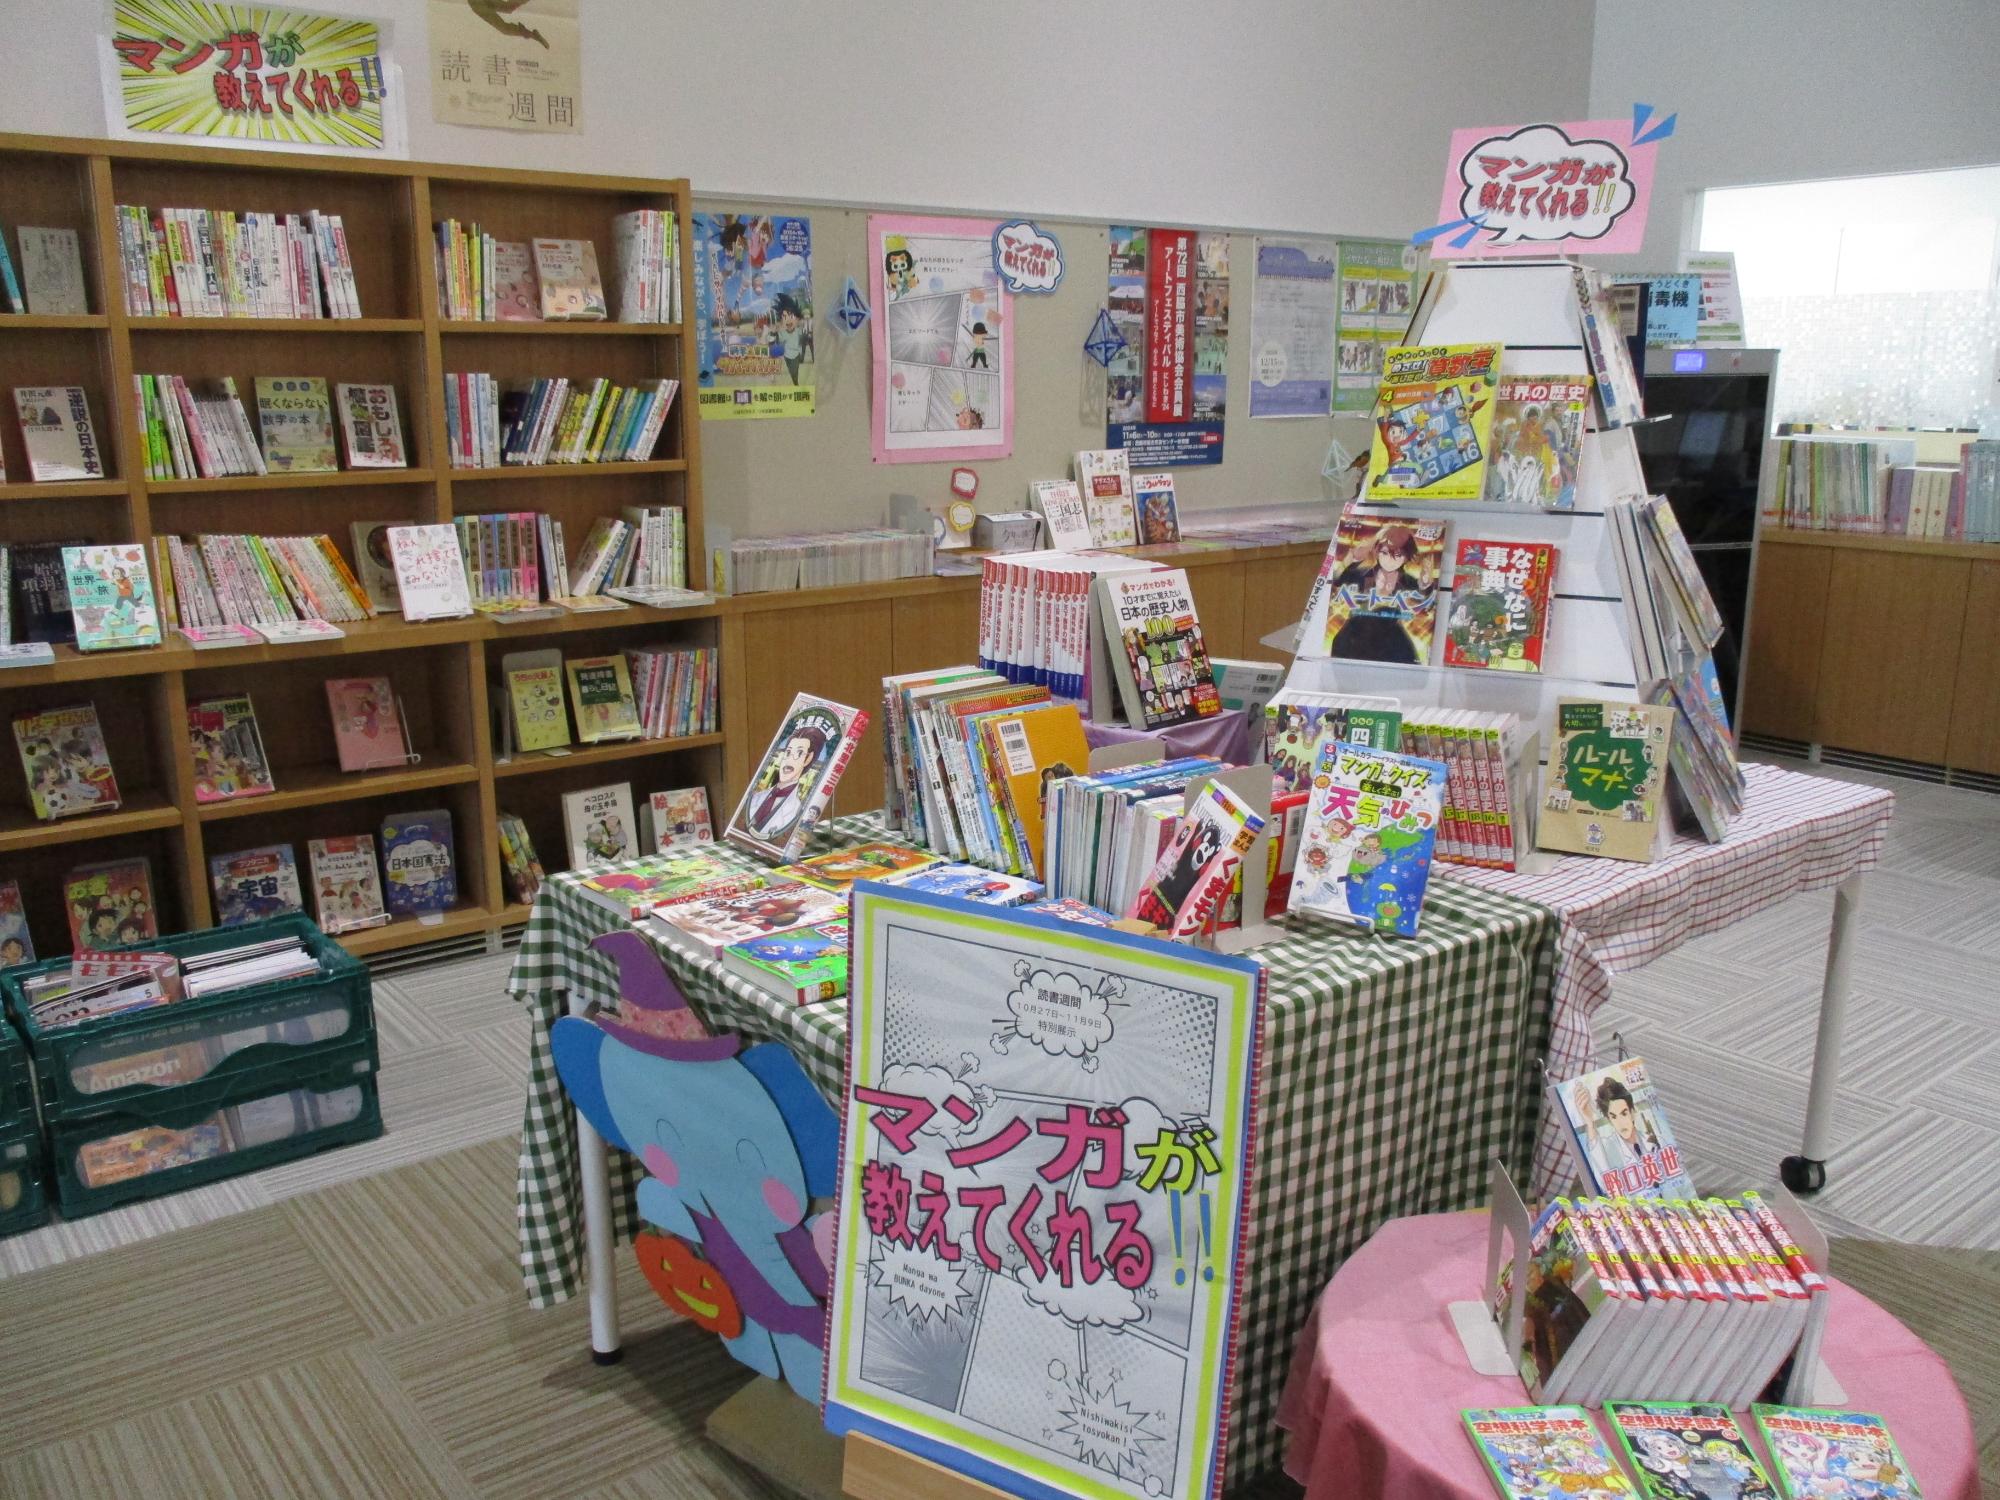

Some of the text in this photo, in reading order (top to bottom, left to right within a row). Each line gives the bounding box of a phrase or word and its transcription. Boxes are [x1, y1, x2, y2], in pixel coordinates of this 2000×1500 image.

[112, 30, 305, 74] マンガが
[440, 50, 511, 86] 読書
[508, 92, 574, 127] 週間
[1476, 155, 1617, 187] マンガが
[1176, 236, 1188, 278] 第72回
[1162, 247, 1174, 368] アートフェスティバル
[1648, 290, 1690, 309] 毒機
[258, 396, 328, 410] 眠くならない
[1381, 391, 1394, 402] 4
[1500, 384, 1586, 402] 世界の歴史
[261, 413, 313, 426] 数学の本
[1048, 502, 1082, 518] 三国志
[1480, 546, 1510, 594] 事典
[1122, 588, 1182, 606] 10才までに覚えたい
[1130, 578, 1176, 592] マンガでわかる!
[1504, 547, 1535, 633] なぜなに
[1120, 598, 1190, 622] 日本の歴史人物
[1144, 614, 1176, 639] 100
[1340, 755, 1433, 790] マンガとクイズで
[1578, 766, 1628, 792] マナー
[1321, 785, 1434, 831] 天気のひみつ
[392, 853, 447, 871] 日本国憲法
[238, 875, 279, 900] 宇宙
[1036, 987, 1082, 1010] 読書週間
[1037, 1020, 1078, 1039] 特別展示
[87, 1056, 182, 1093] Amazon
[854, 1085, 1222, 1195] マンガが
[1602, 1146, 1686, 1199] 野口英世
[860, 1157, 1216, 1290] 教えてくれる!!
[902, 1262, 939, 1283] Manga wa
[894, 1272, 947, 1300] BUNKA dayone
[1080, 1406, 1135, 1436] Nishiwakisi
[1472, 1418, 1590, 1436] 空想科学読本
[1615, 1414, 1736, 1432] 空想科学読本
[1759, 1416, 1888, 1439] 空想科学読本
